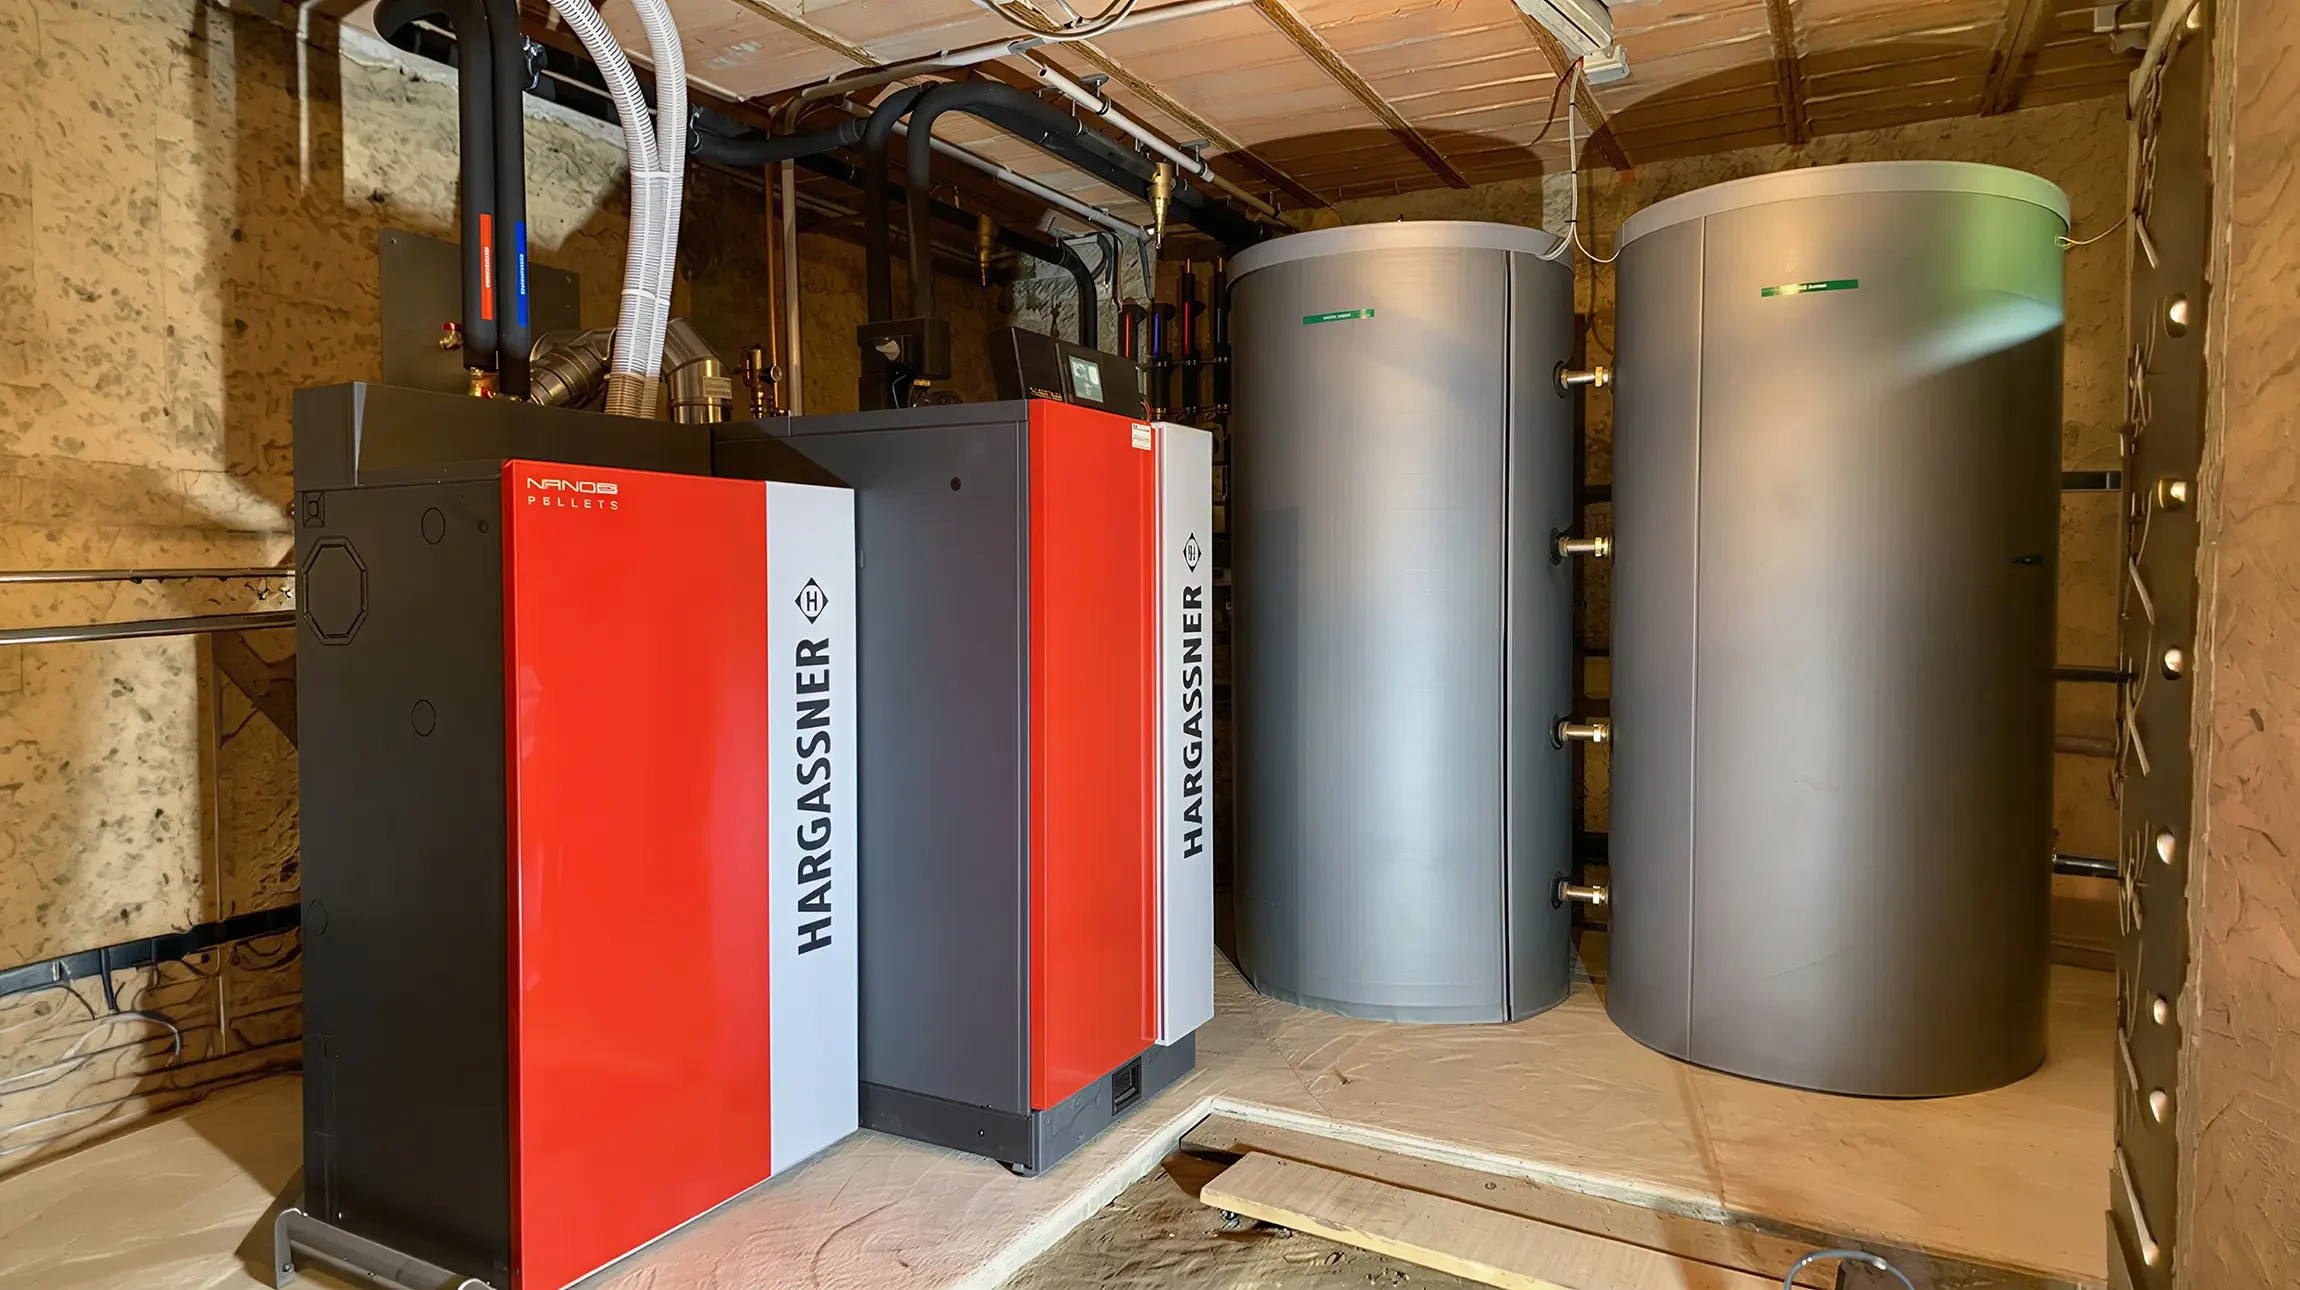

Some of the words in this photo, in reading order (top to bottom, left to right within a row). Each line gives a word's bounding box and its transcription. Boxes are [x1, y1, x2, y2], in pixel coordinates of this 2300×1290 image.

[527, 495, 619, 511] PELLETS
[795, 637, 832, 956] HARGASSNER
[1182, 585, 1203, 860] HARGASSNER
